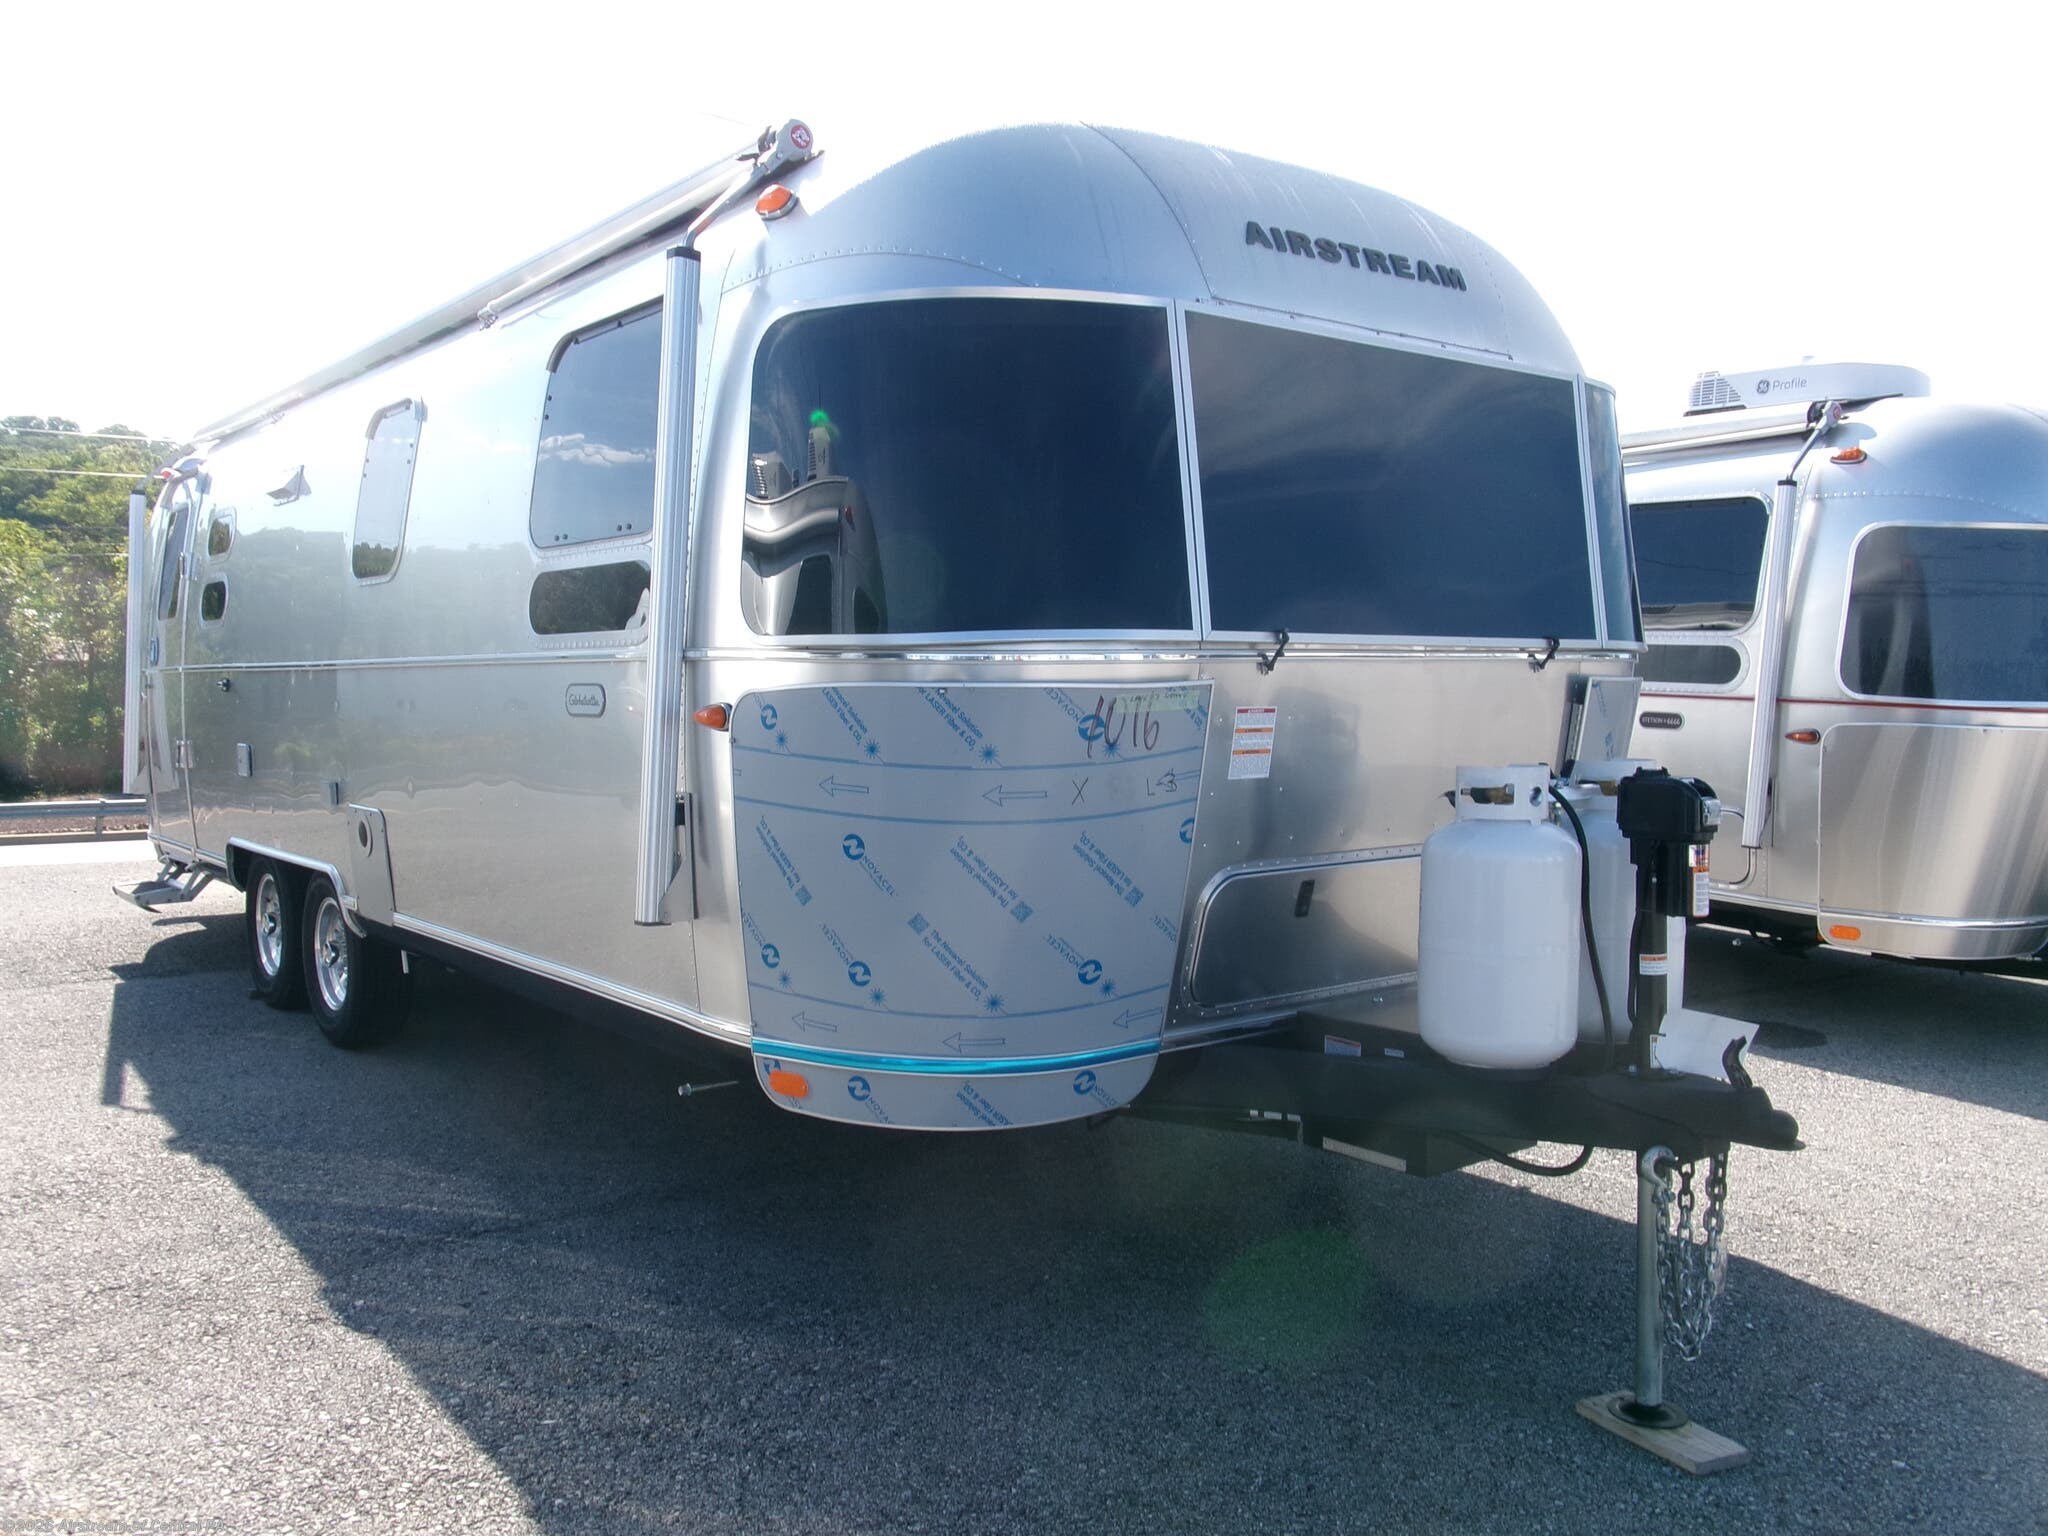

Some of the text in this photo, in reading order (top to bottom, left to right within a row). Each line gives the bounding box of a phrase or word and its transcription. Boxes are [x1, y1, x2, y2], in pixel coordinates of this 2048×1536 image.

[1245, 220, 1467, 292] AIRSTREAM
[1772, 377, 1807, 391] Profile
[1071, 776, 1089, 806] X
[862, 855, 896, 896] NOVACEL
